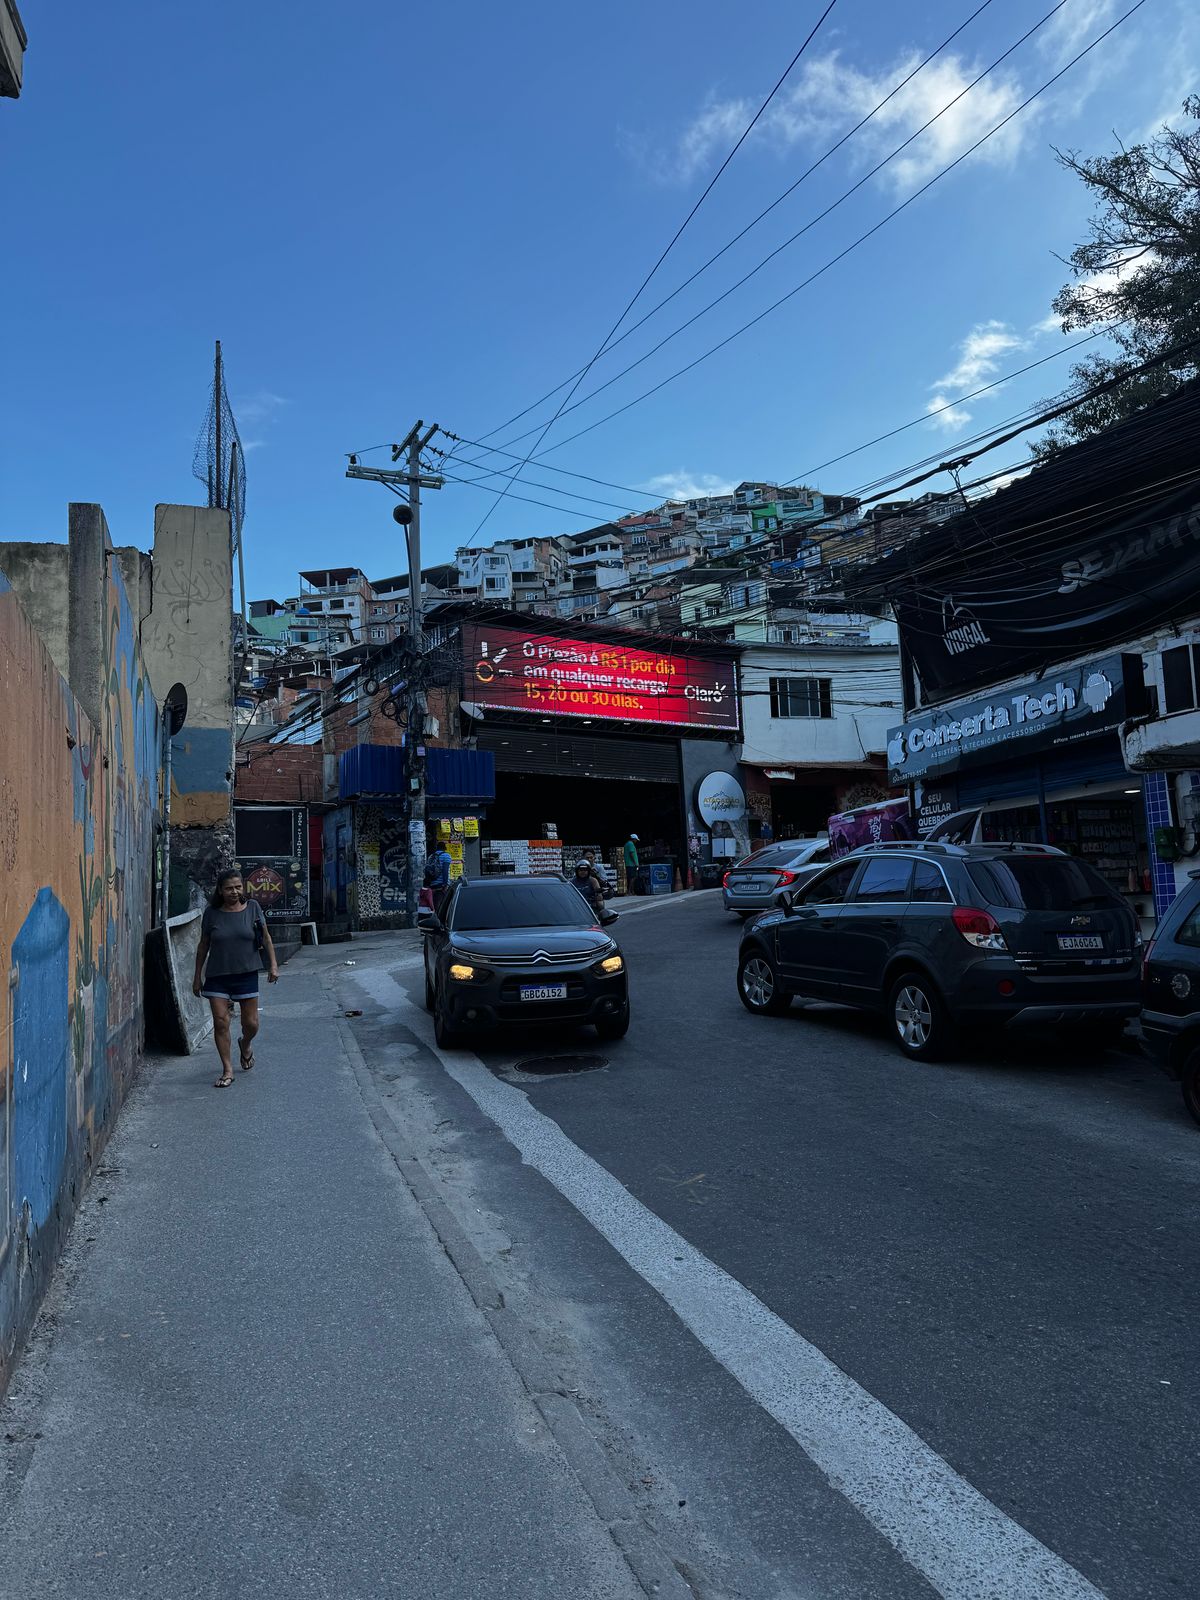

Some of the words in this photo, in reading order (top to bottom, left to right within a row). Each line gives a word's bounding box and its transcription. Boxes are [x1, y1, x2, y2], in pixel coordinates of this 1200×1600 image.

[942, 620, 991, 656] VIDIGAL
[522, 641, 534, 657] O
[538, 644, 587, 665] Prezão
[630, 659, 653, 674] por
[655, 659, 676, 675] dia
[523, 665, 548, 678] em
[550, 667, 614, 688] qualquer
[524, 682, 545, 702] 15,
[548, 684, 567, 702] 20
[570, 691, 588, 704] ou
[591, 689, 609, 706] 30
[612, 693, 644, 710] dias.
[684, 684, 724, 703] Claro
[908, 704, 1011, 754] Conserta
[1011, 682, 1076, 724] Tech
[928, 792, 942, 804] SEU
[920, 802, 952, 816] CELULAR
[918, 813, 951, 827] QUEBRO
[1062, 937, 1099, 949] EJA6C61
[524, 988, 562, 1000] GBC6152
